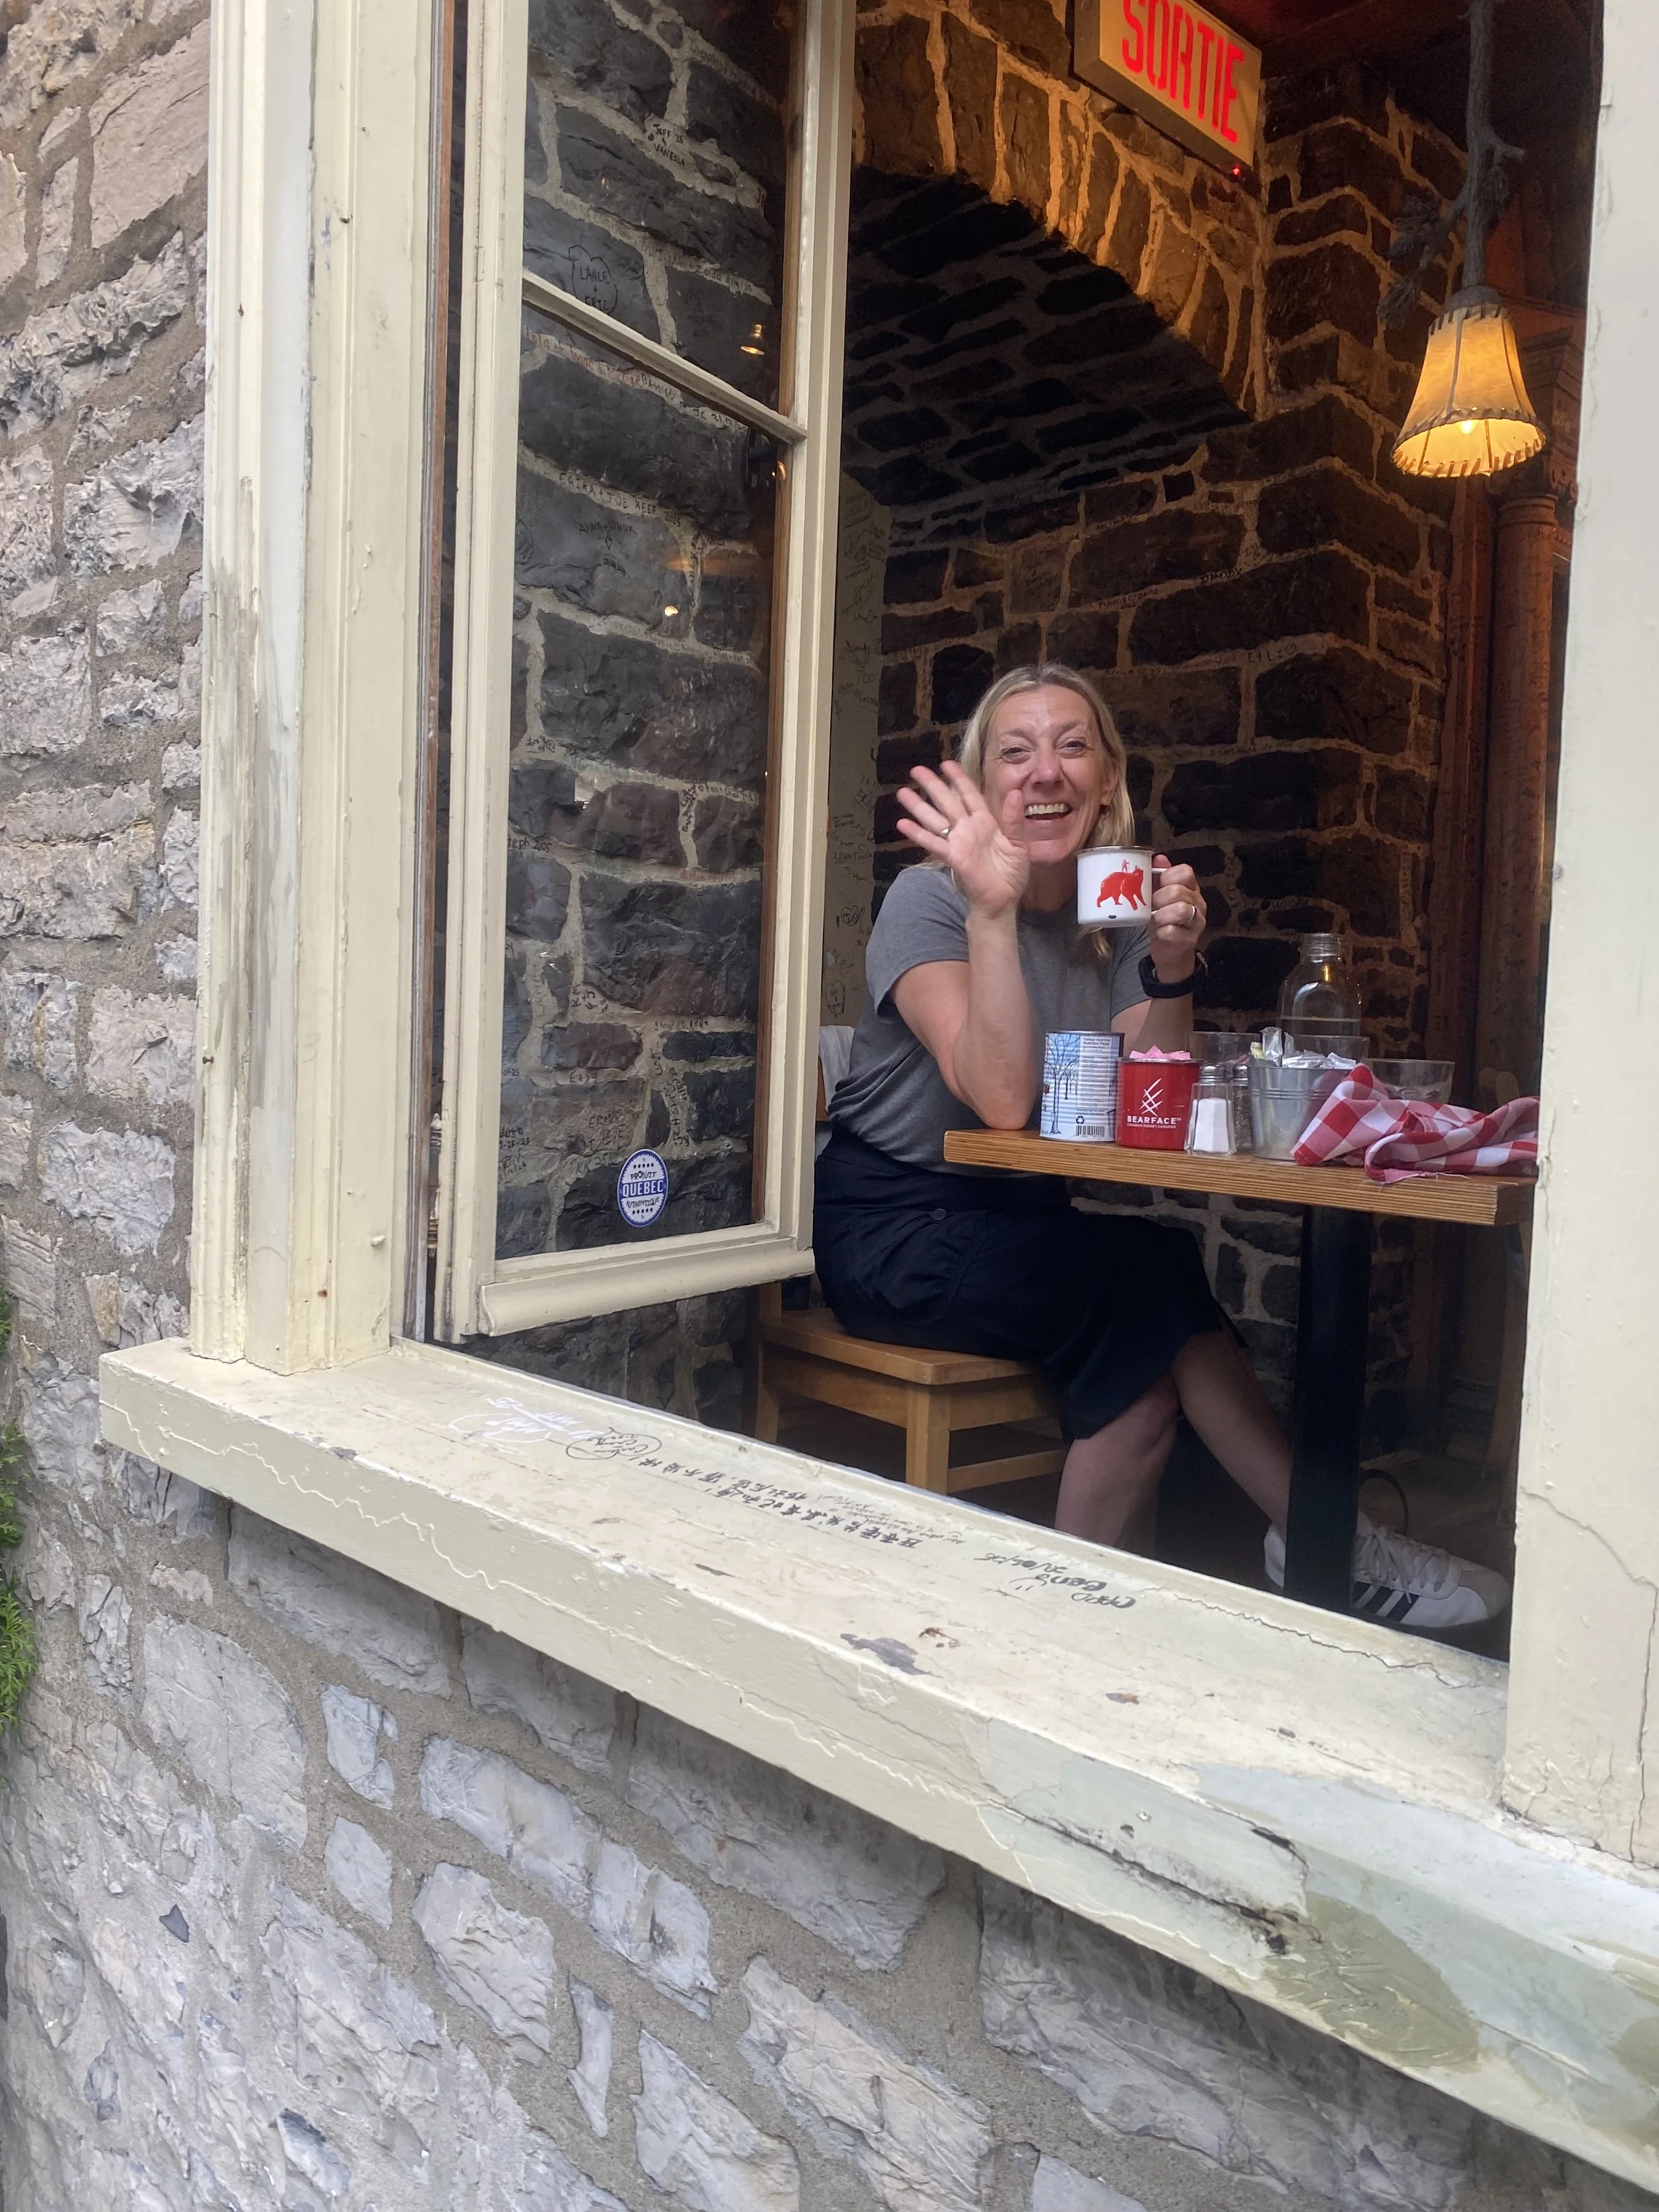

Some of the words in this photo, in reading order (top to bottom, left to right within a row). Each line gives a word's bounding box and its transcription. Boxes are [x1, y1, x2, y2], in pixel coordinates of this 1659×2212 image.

[1121, 0, 1245, 144] SORTIE
[653, 122, 670, 138] JEFF
[653, 143, 685, 169] VANESSA
[580, 266, 608, 283] LANCE
[559, 472, 596, 496] ERIKA
[607, 492, 628, 510] JOE
[1127, 1115, 1177, 1124] BEARFACE
[630, 1170, 657, 1181] PRODUIT
[622, 1179, 664, 1198] QUEBEC
